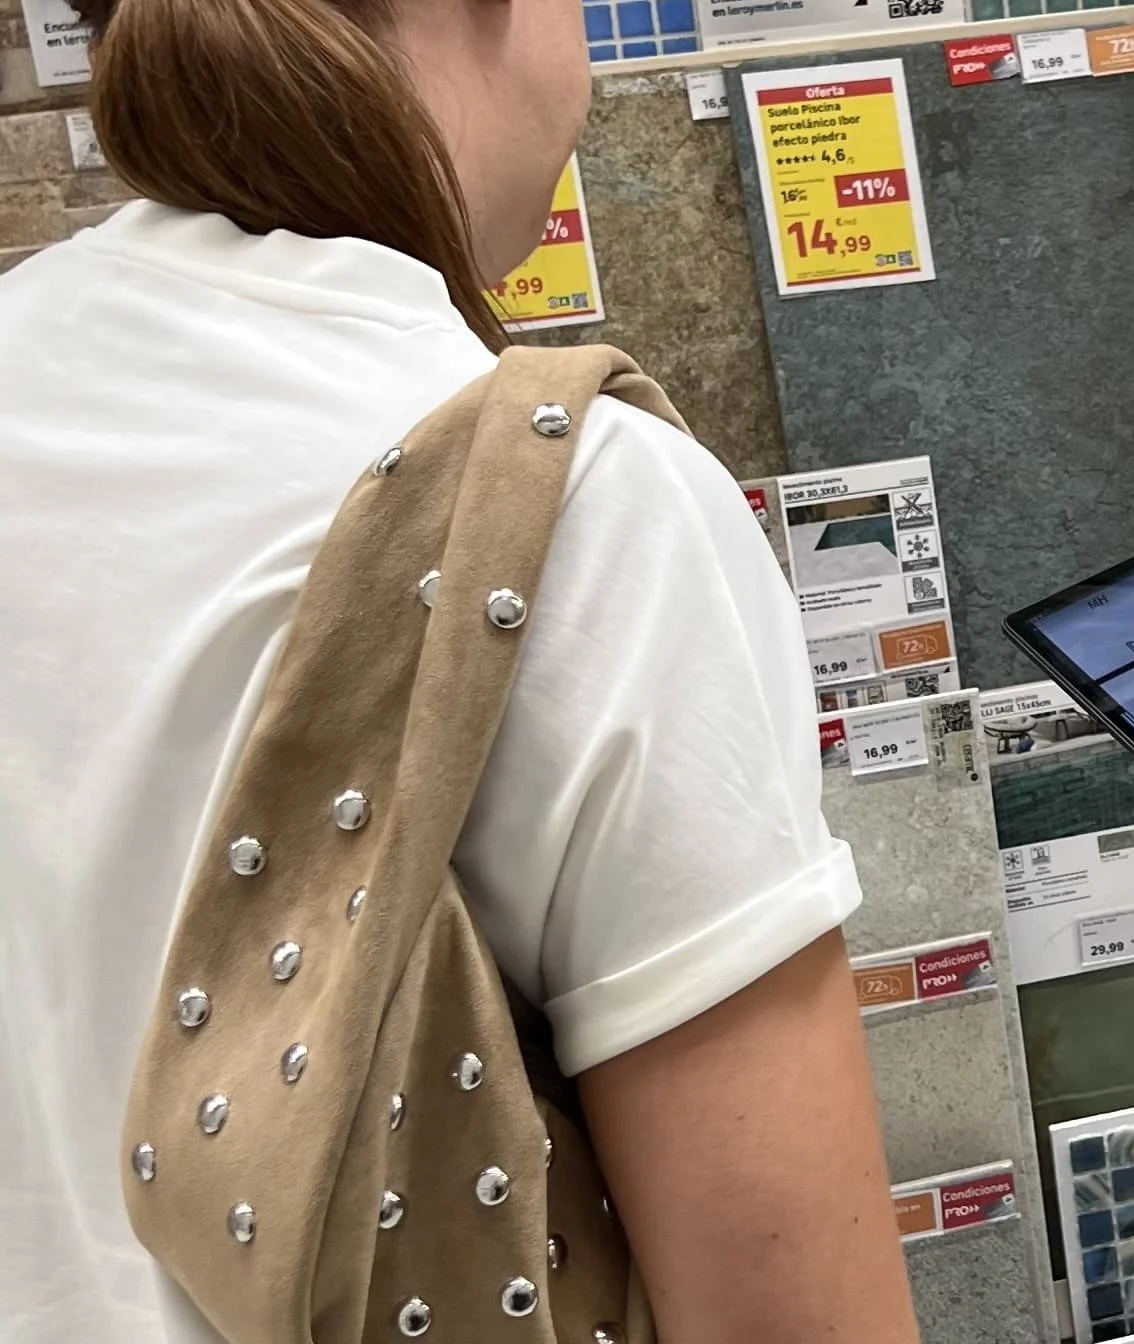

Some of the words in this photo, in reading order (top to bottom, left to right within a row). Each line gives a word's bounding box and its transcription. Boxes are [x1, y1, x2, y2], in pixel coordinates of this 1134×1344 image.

[712, 7, 726, 17] en
[950, 41, 1012, 60] Condiciones
[1032, 56, 1064, 70] 16,99
[805, 86, 845, 99] Oferta
[702, 96, 728, 109] 16,9
[767, 106, 799, 118] Suelo
[801, 102, 841, 115] Piscina
[770, 116, 836, 133] porcelánico
[838, 114, 861, 126] Ibor
[772, 135, 808, 148] efecto
[811, 132, 847, 146] piedra
[821, 149, 846, 165] 4,6
[842, 177, 896, 201] -11%
[787, 218, 871, 259] 14,99
[814, 661, 848, 676] 16,99
[995, 704, 1014, 714] SAGE
[864, 743, 898, 759] 16,99
[1091, 942, 1124, 956] 29,99
[919, 949, 986, 973] Condiciones
[942, 1182, 1010, 1203] Condiciones
